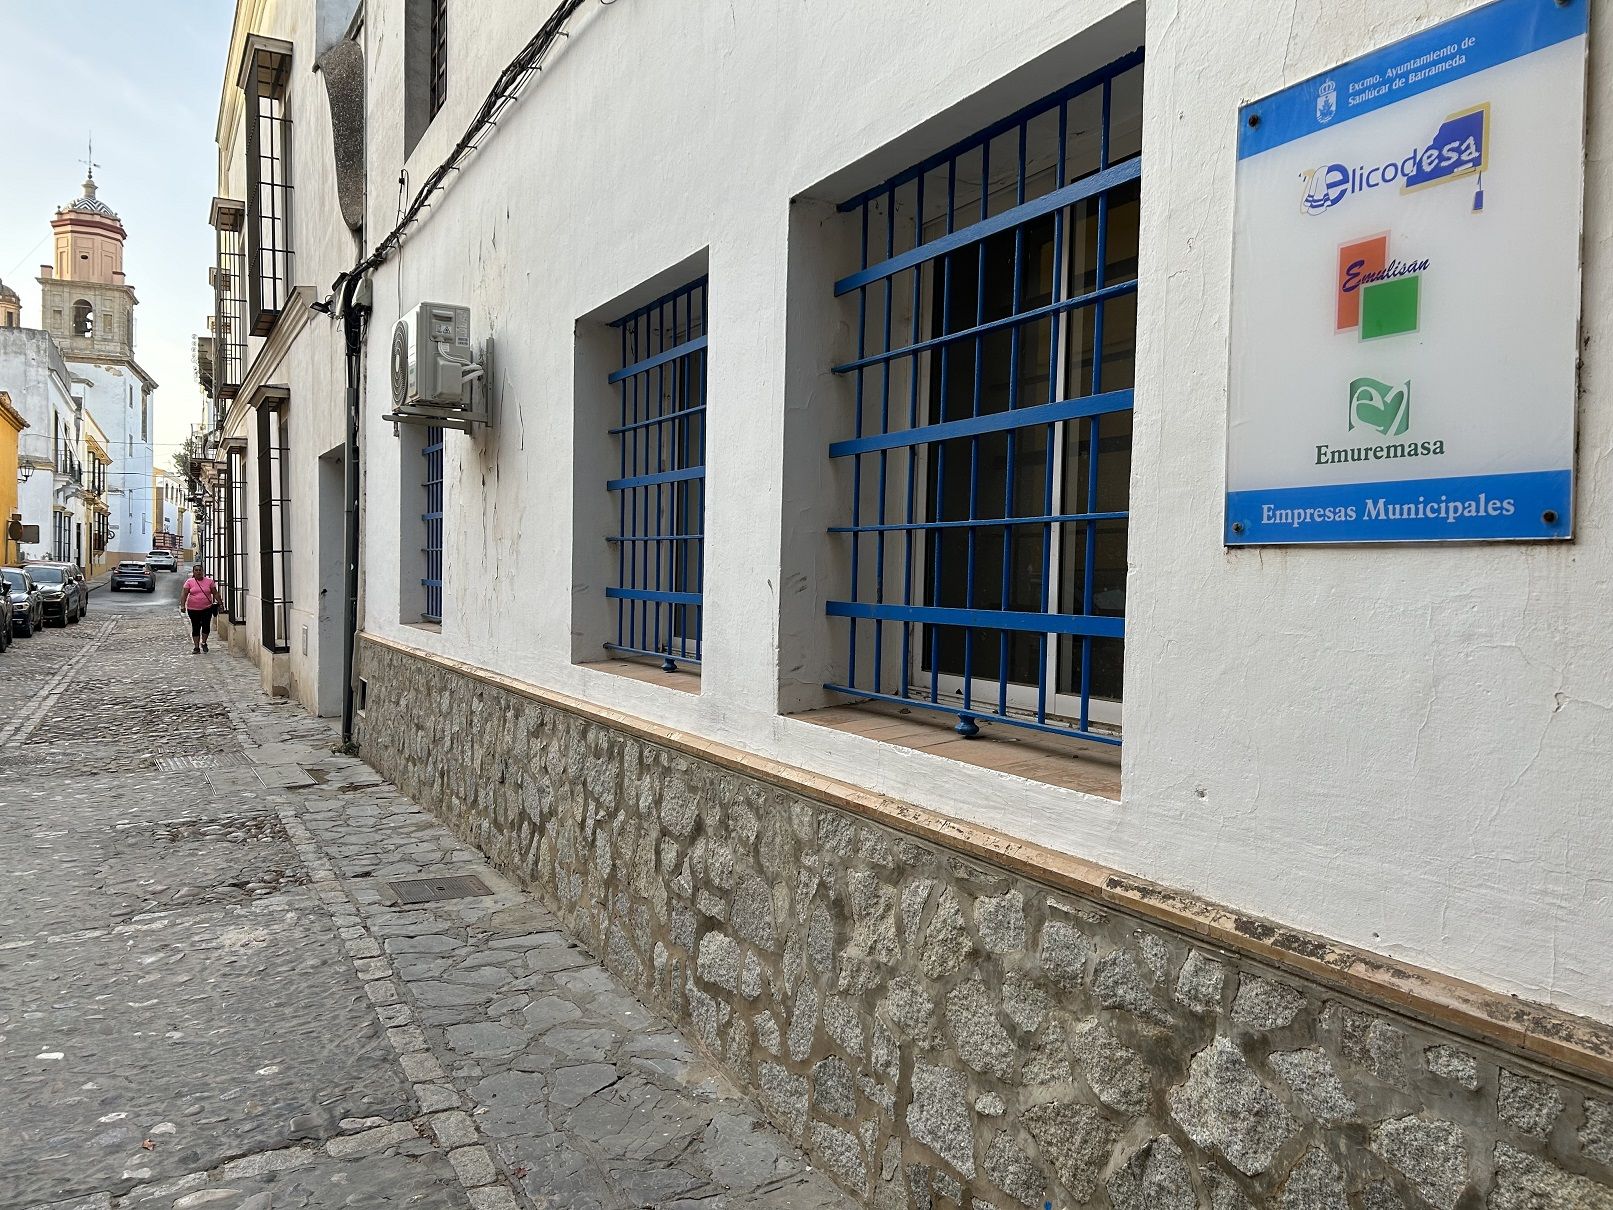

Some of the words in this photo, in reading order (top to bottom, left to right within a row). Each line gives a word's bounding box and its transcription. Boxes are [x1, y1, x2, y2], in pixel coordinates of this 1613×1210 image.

[1347, 83, 1390, 107] Sanlúcar
[1392, 76, 1406, 90] de
[1408, 54, 1467, 84] Barrameda
[1348, 74, 1383, 93] Excmo.
[1385, 43, 1458, 79] Ayuntamiento
[1461, 36, 1476, 50] de
[1315, 439, 1446, 465] Emuremasa
[1261, 504, 1357, 528] Empresas
[1362, 493, 1516, 524] Municipales
